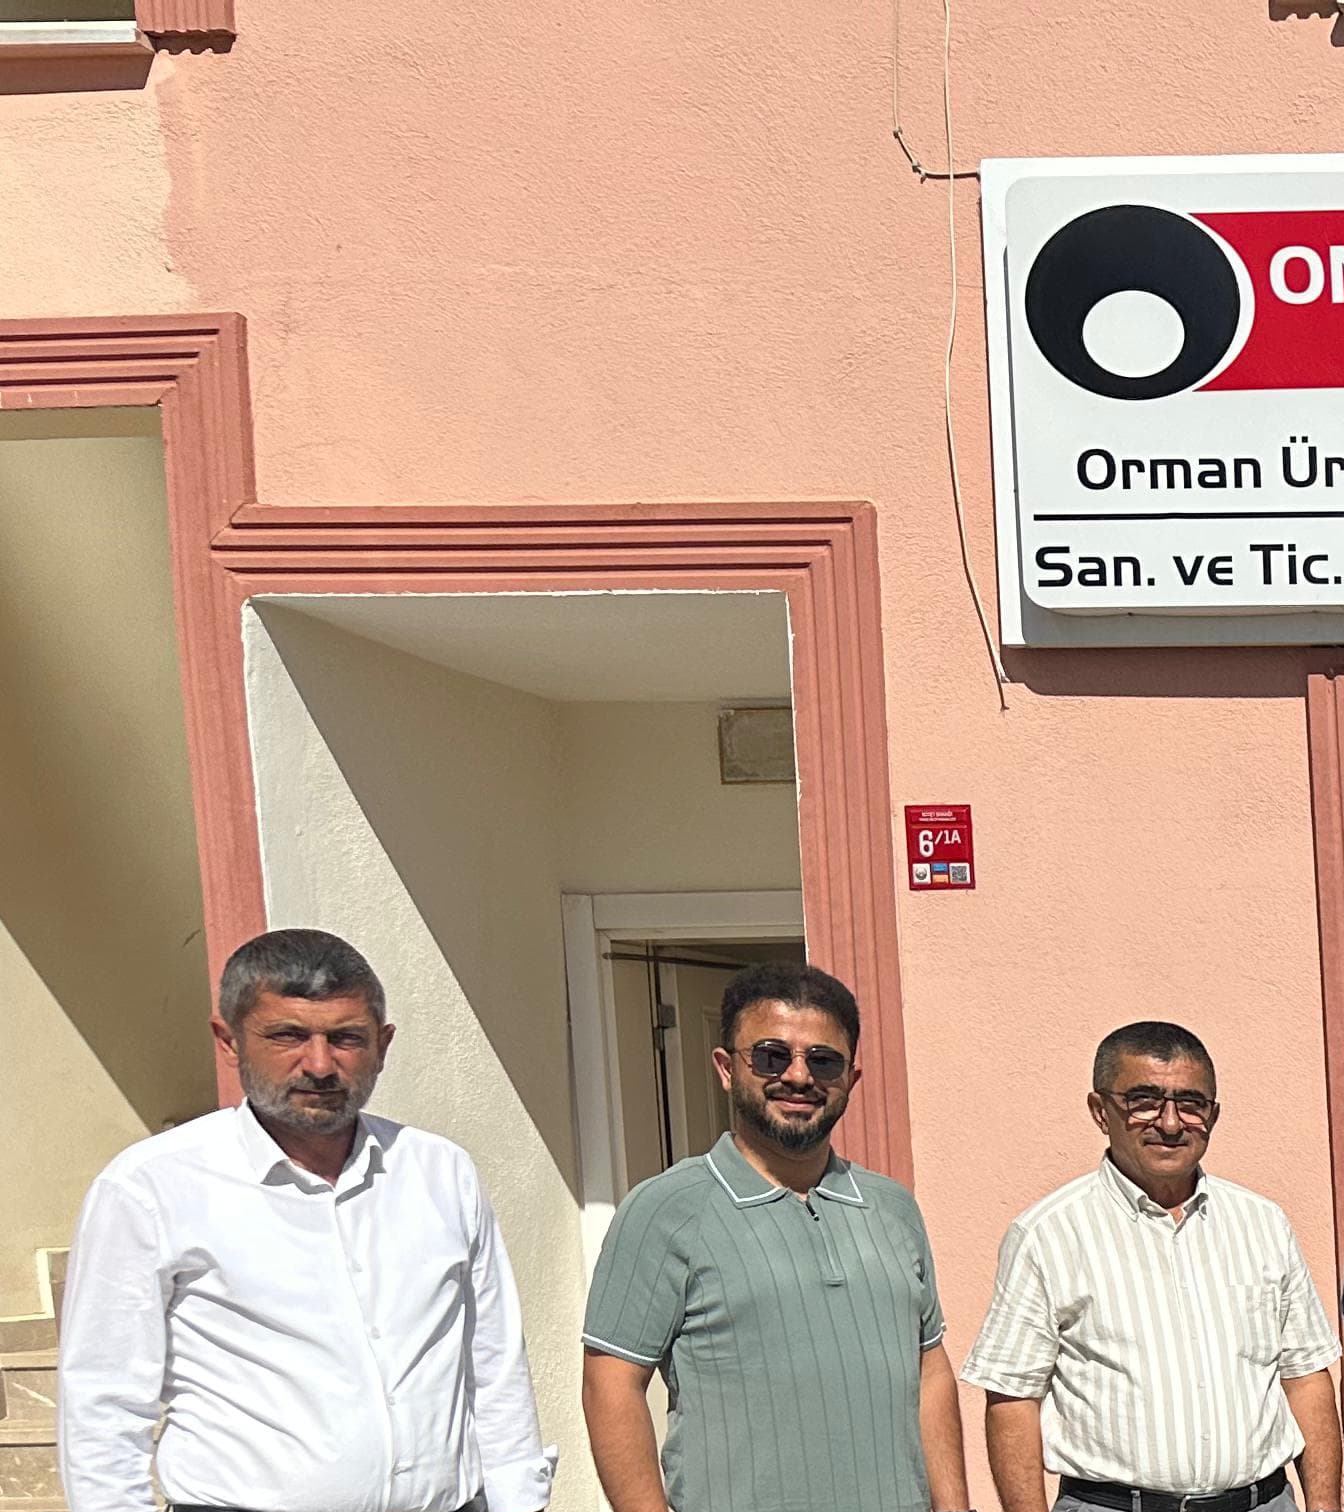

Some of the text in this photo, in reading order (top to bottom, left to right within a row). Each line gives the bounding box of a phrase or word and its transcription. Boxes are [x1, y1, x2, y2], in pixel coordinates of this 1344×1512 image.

[1077, 448, 1262, 491] Orman
[1035, 546, 1155, 588] San.
[1172, 555, 1234, 586] ve
[1249, 542, 1342, 585] Tic.
[919, 829, 961, 858] 6/1A
